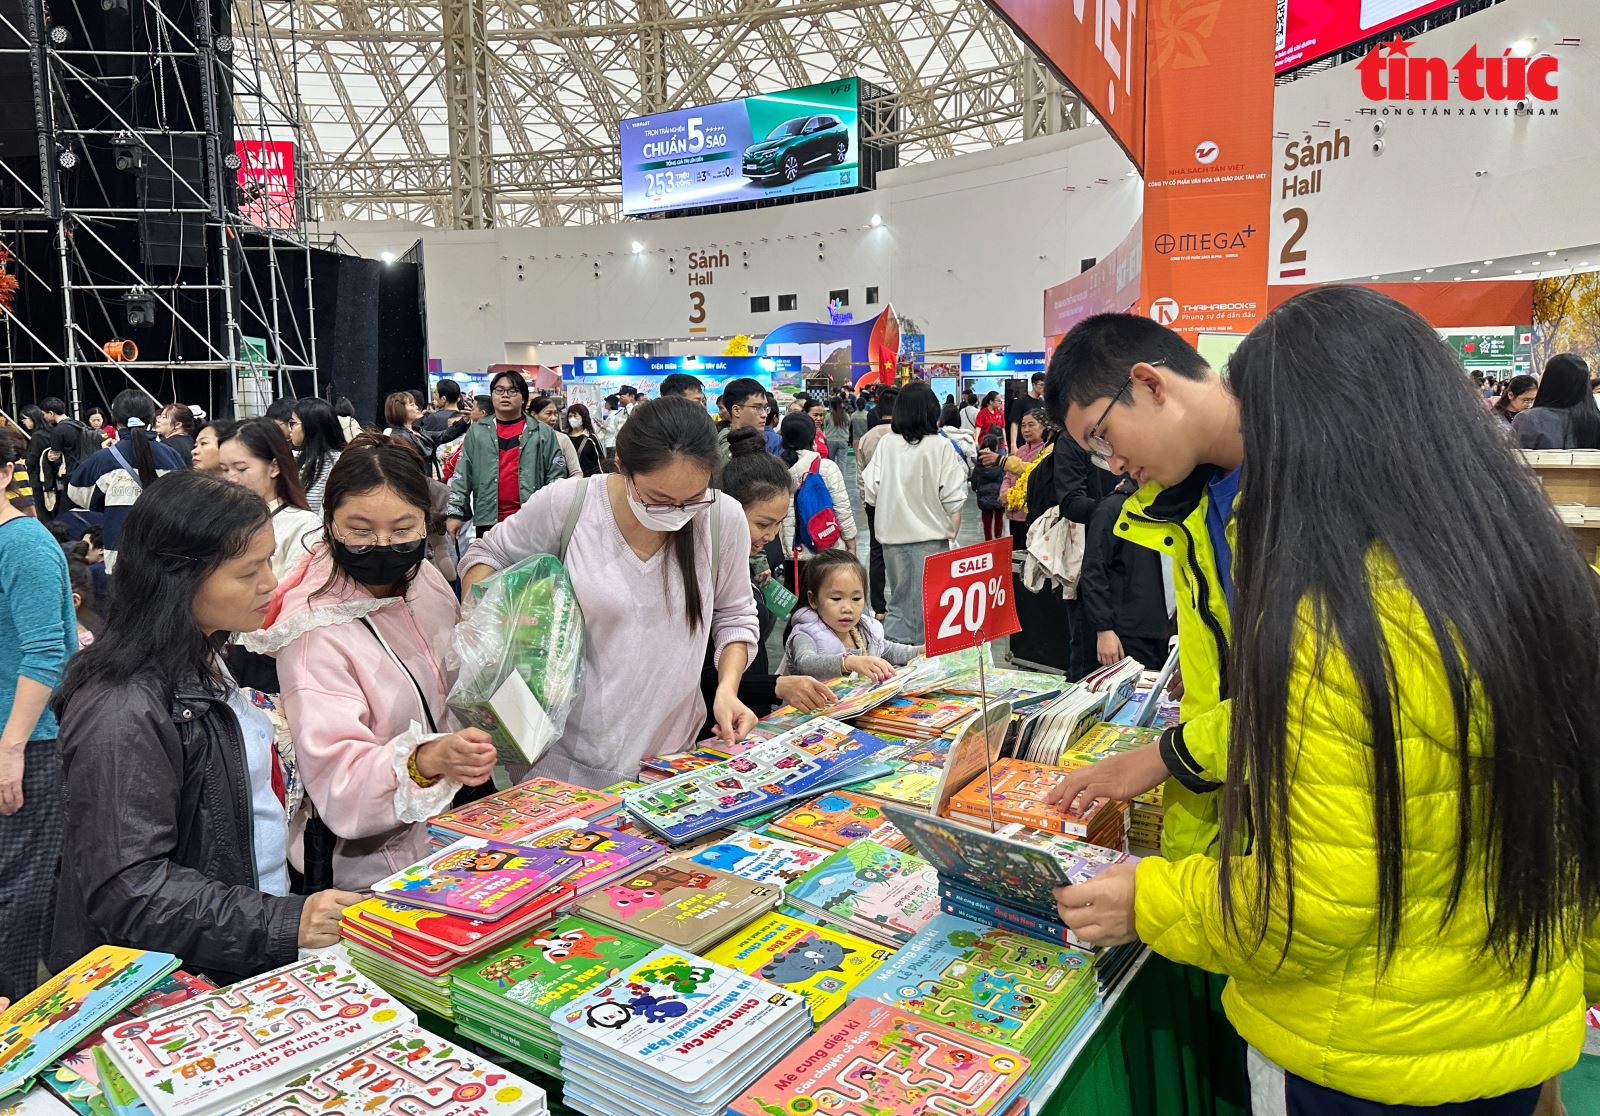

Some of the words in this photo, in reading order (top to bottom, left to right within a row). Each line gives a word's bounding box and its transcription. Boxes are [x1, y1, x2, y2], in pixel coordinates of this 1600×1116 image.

[643, 134, 687, 159] CHUẨN
[687, 117, 705, 154] 5
[705, 133, 727, 149] SAO
[1283, 128, 1350, 172] Sảnh
[1168, 168, 1186, 176] NHÀ
[1187, 166, 1209, 175] SÁCH
[1210, 165, 1226, 173] TÂN
[1228, 164, 1246, 172] VIỆT
[644, 171, 676, 198] 253
[1281, 170, 1322, 200] Hall
[1279, 207, 1309, 265] 2
[688, 250, 730, 270] Sảnh
[688, 271, 714, 286] Hall
[688, 291, 707, 324] 3
[1181, 312, 1204, 321] Phụng
[1206, 312, 1215, 321] sự
[1215, 311, 1226, 319] để
[1227, 310, 1241, 319] dẫn
[1242, 311, 1256, 319] đầu
[1182, 302, 1257, 312] THAIHABOOKS
[1022, 358, 1034, 366] LỊCH
[958, 557, 988, 574] SALE
[937, 576, 1006, 640] 20%
[484, 877, 512, 891] của
[761, 931, 777, 943] con
[777, 923, 789, 934] và
[786, 927, 805, 940] Mèo
[732, 942, 762, 961] chuột
[766, 939, 787, 953] Béo
[876, 968, 896, 982] Mê
[892, 951, 917, 969] cung
[911, 937, 931, 953] diệu
[926, 928, 940, 938] kì
[897, 969, 913, 980] Lễ
[907, 953, 932, 971] Phục
[928, 939, 948, 954] sinh
[574, 965, 606, 983] rau
[737, 979, 753, 991] và
[702, 991, 739, 1018] những
[728, 998, 760, 1021] Chim
[321, 1019, 350, 1034] Trái
[334, 1022, 362, 1038] Mê
[668, 1017, 708, 1042] người
[700, 1019, 733, 1041] Cánh
[295, 1030, 319, 1042] tim
[500, 1031, 510, 1041] rau
[270, 1039, 295, 1054] yêu
[283, 1036, 330, 1059] cung
[638, 1039, 671, 1057] bạn
[674, 1041, 705, 1056] Cụt
[774, 1073, 798, 1091] Mê
[795, 1049, 829, 1073] cung
[823, 1029, 849, 1050] diệu
[843, 1019, 861, 1030] kì
[216, 1051, 267, 1075] thương
[237, 1055, 281, 1078] diệu
[794, 1078, 817, 1094] Câu
[813, 1053, 846, 1079] chuyện
[843, 1041, 854, 1054] cổ
[851, 1030, 872, 1045] tích
[213, 1074, 234, 1088] kì
